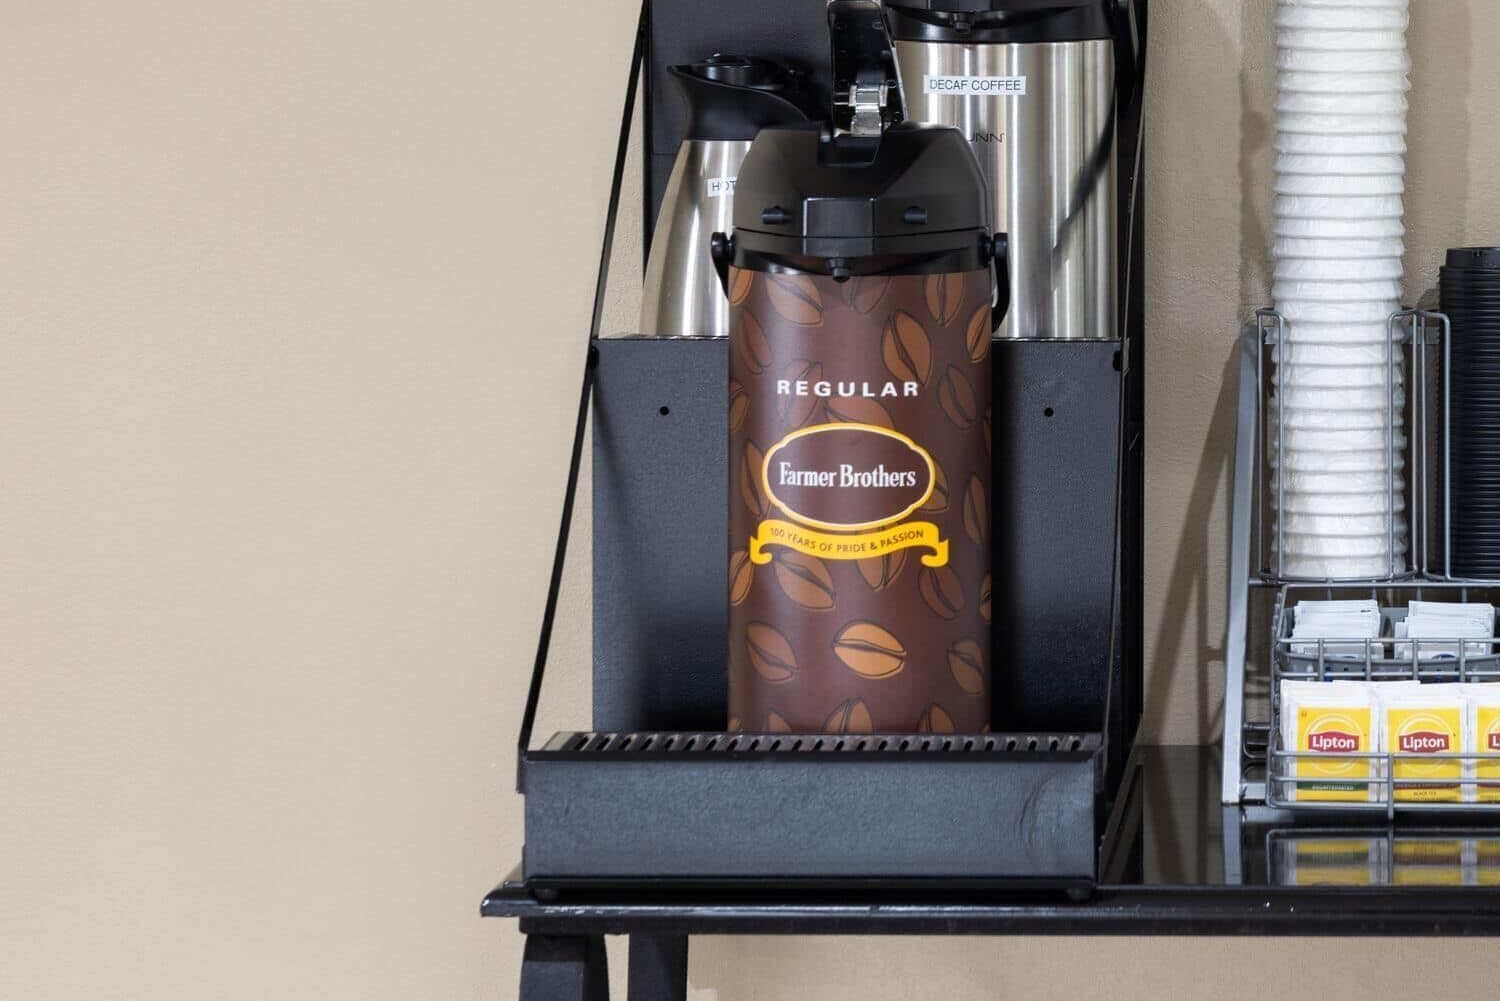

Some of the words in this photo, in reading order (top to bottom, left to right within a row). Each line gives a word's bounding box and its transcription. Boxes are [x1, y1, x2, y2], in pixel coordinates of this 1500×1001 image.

[929, 79, 968, 90] DECAF
[971, 79, 1022, 91] COFFEE
[967, 132, 1005, 143] UNN
[711, 180, 737, 192] HOT
[776, 380, 919, 397] REGULAR
[779, 461, 837, 488] Farmer
[840, 464, 916, 488] Brothers
[770, 527, 785, 538] 100
[787, 532, 816, 549] YEARS
[819, 542, 833, 551] OF
[836, 543, 866, 553] PRIDE
[870, 542, 878, 550] &
[880, 529, 924, 548] PASSION
[1311, 735, 1356, 750] Lipton
[1403, 736, 1445, 751] Lipton
